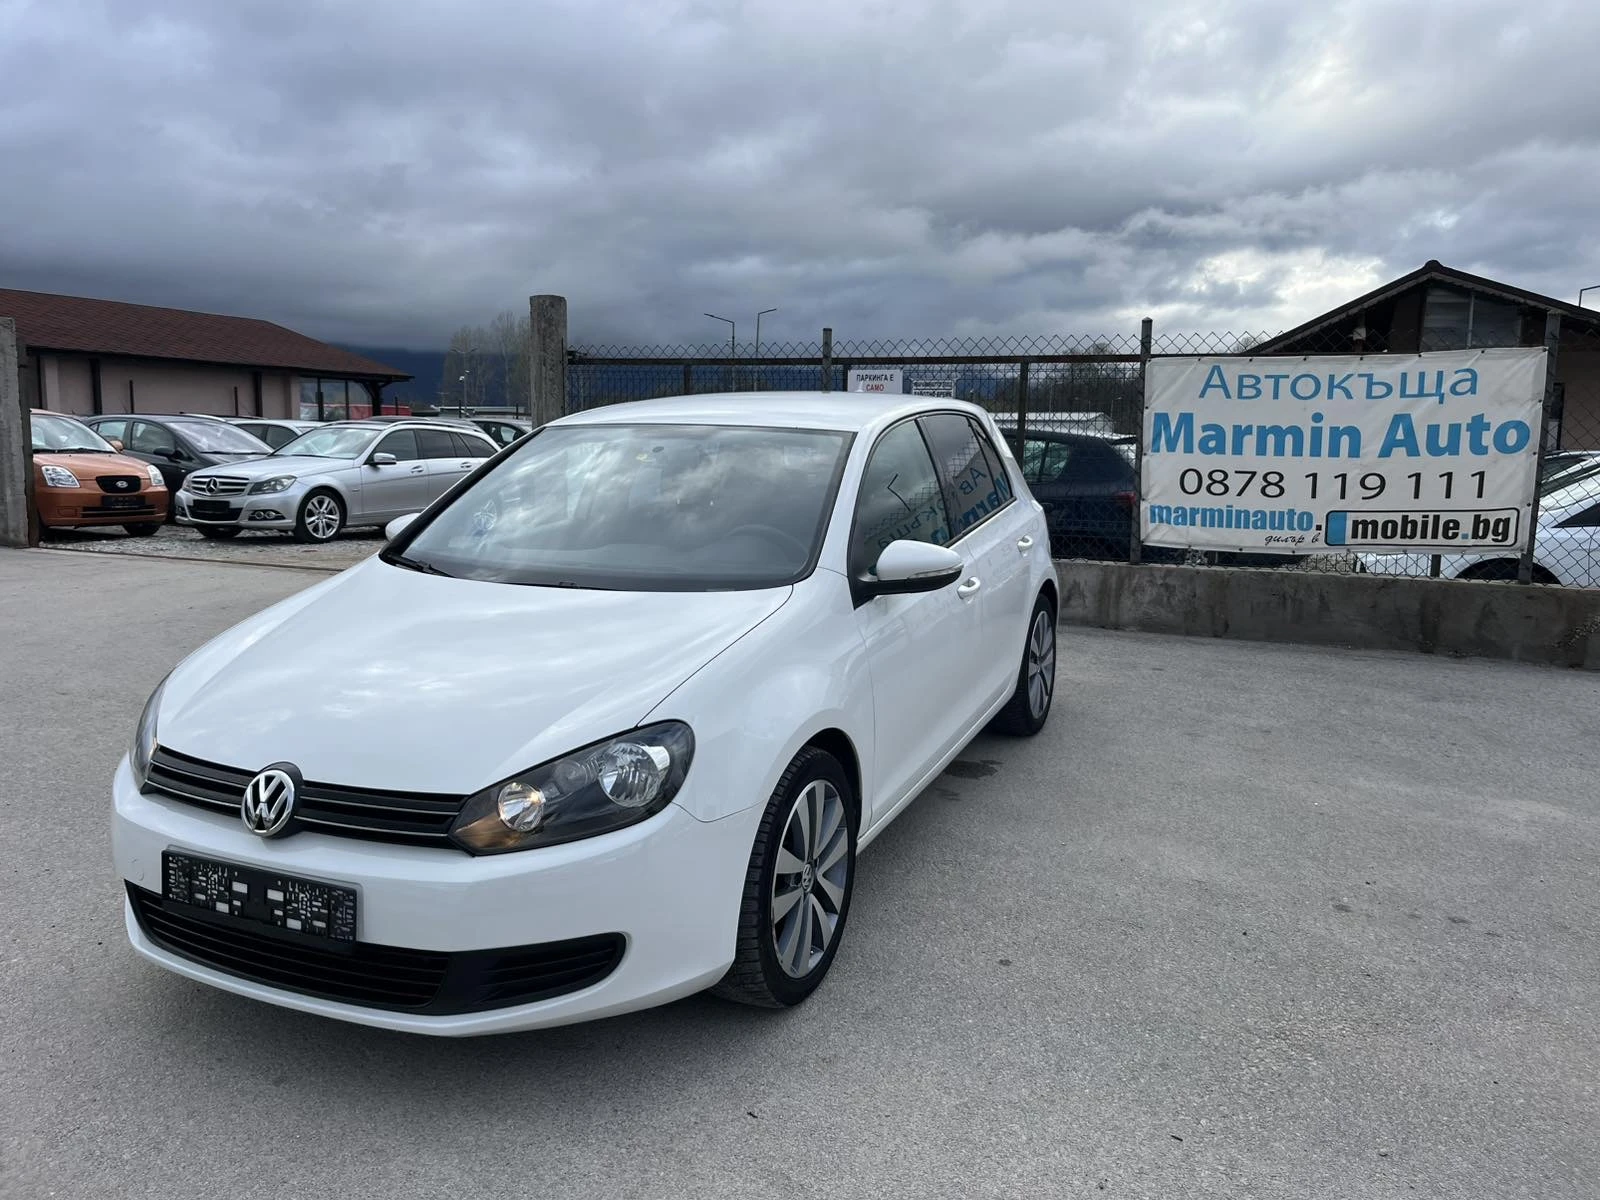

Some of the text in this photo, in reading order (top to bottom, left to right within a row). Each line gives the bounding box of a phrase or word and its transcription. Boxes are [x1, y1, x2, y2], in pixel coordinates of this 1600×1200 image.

[856, 374, 888, 382] ПАРКИНГА
[866, 384, 884, 392] САМО
[1200, 365, 1478, 404] Автокъща
[1151, 412, 1530, 458] Marmin Auto
[1179, 468, 1487, 500] 0878 119 111
[1351, 514, 1511, 543] mobile.bg
